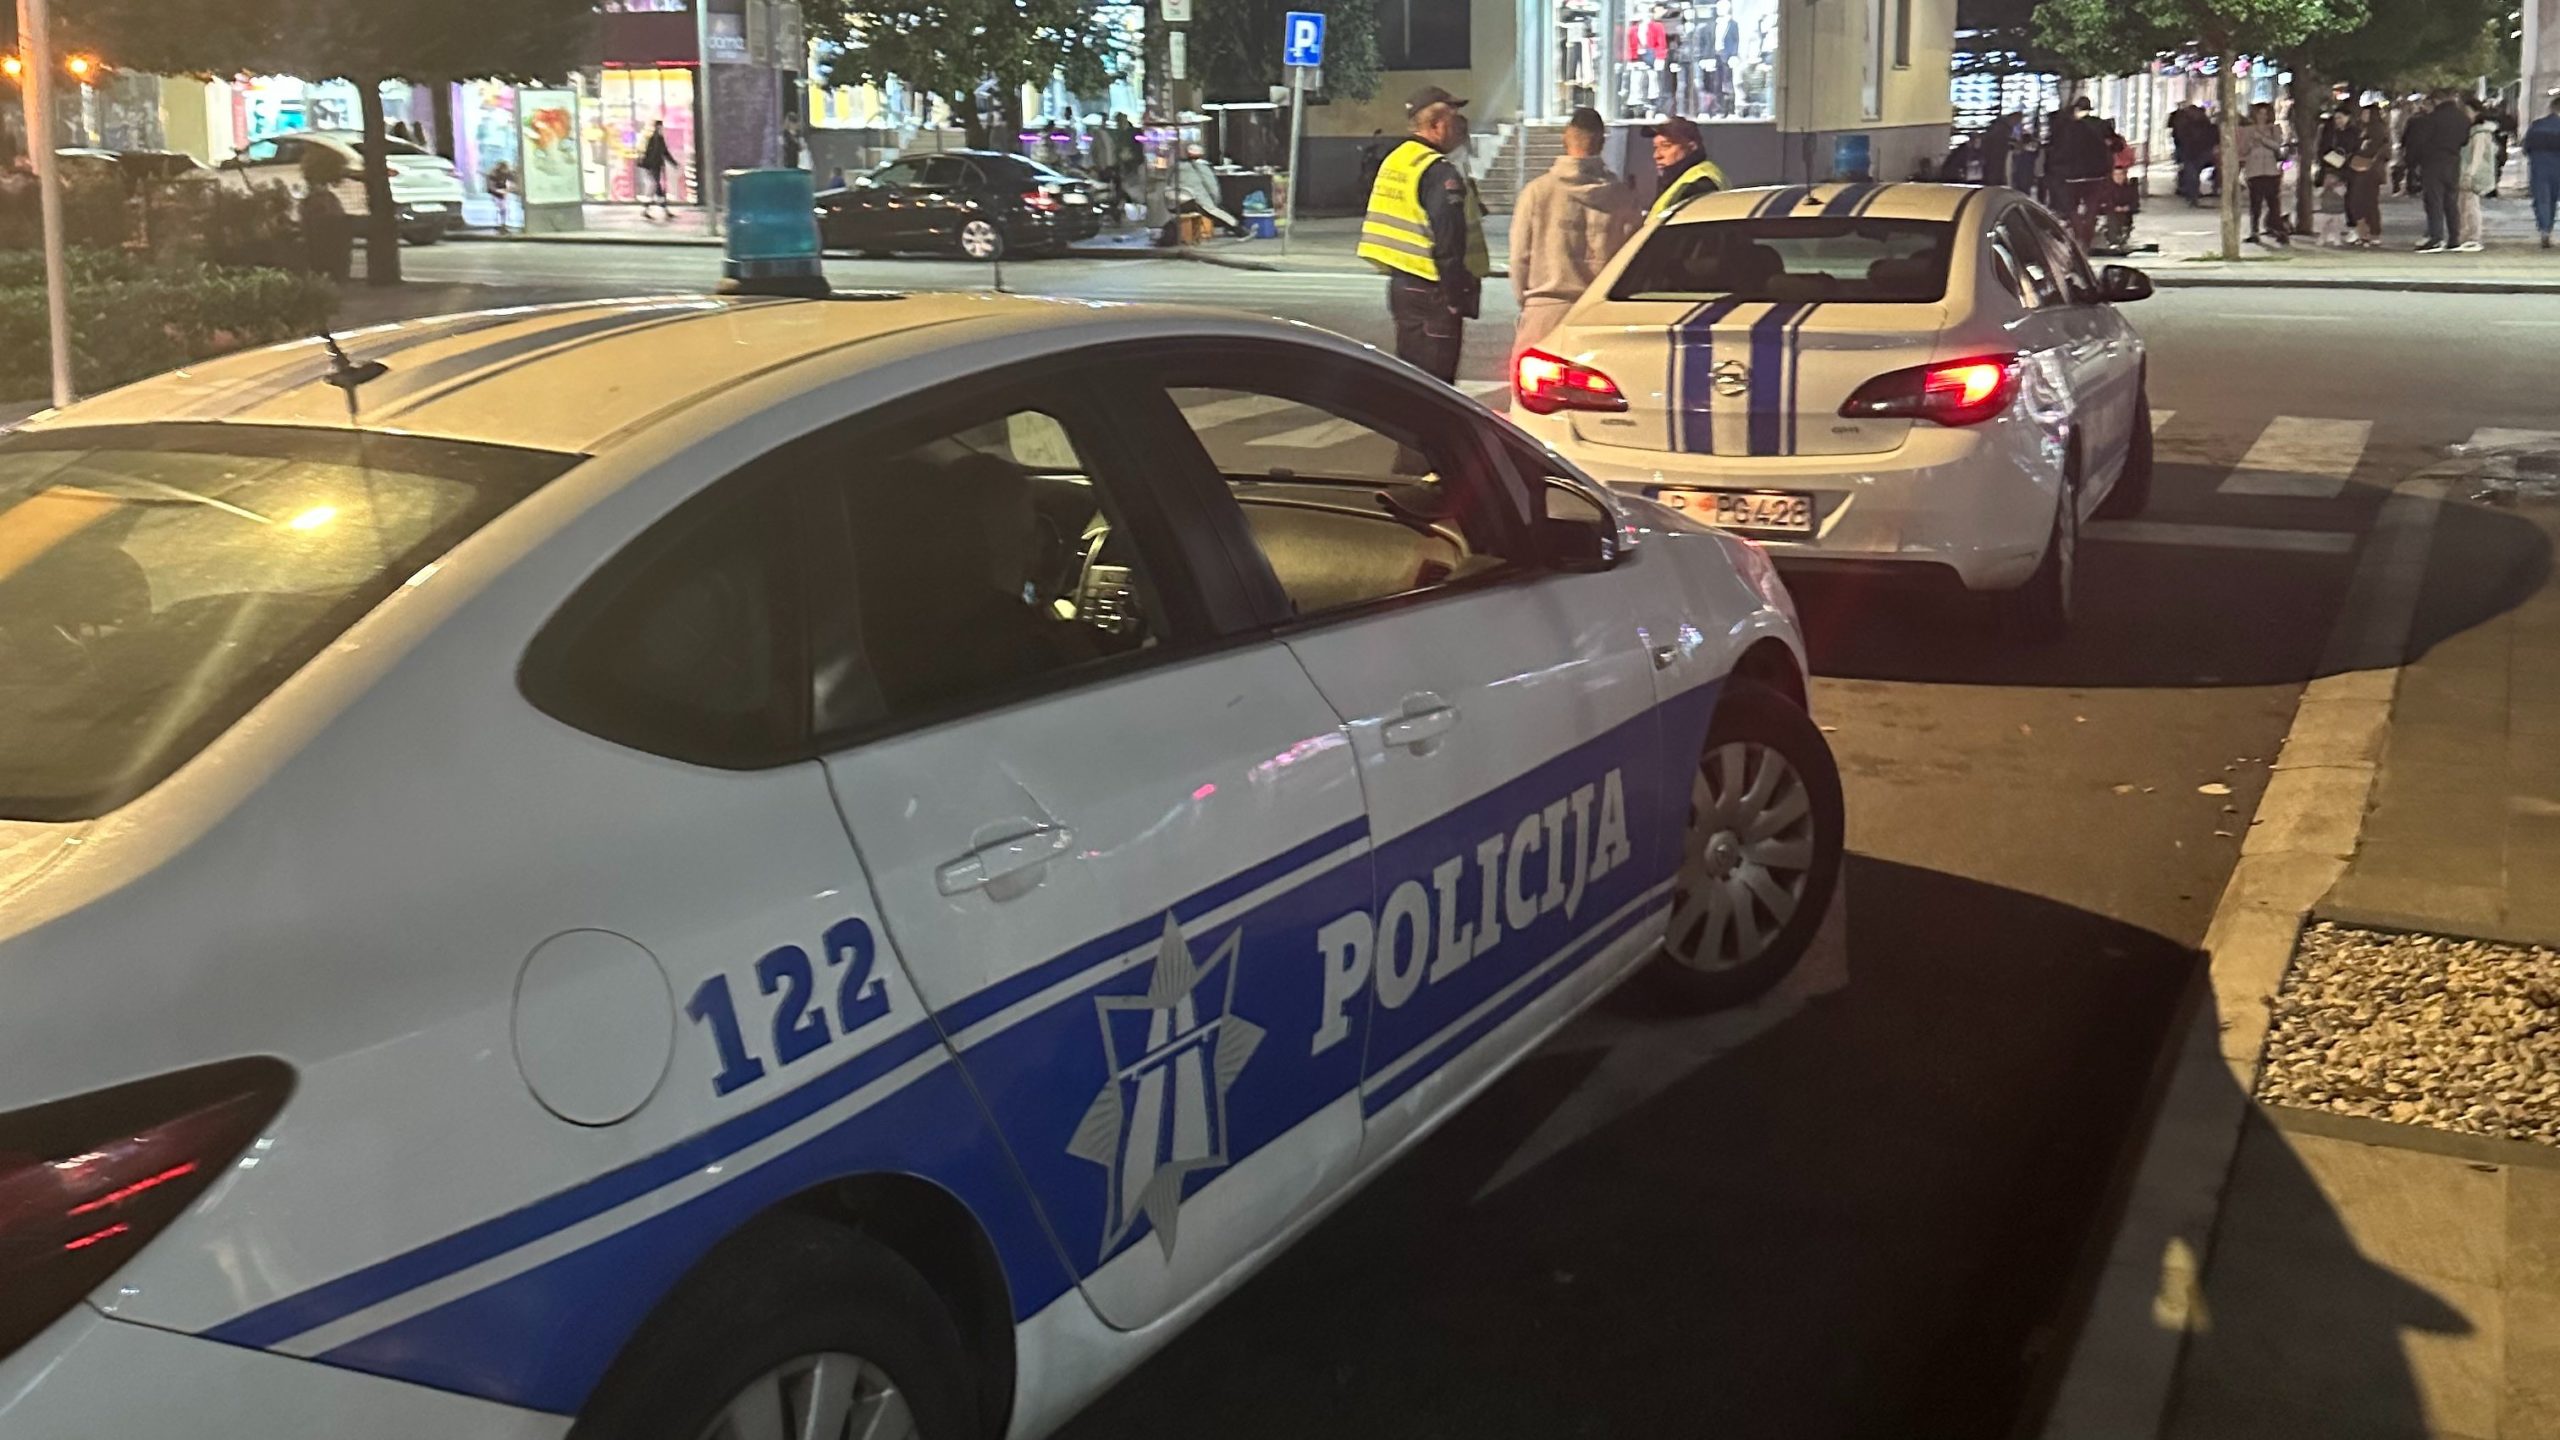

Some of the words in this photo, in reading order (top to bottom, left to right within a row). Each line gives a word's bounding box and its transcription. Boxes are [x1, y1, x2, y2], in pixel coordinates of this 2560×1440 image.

[1294, 20, 1317, 57] P
[1716, 495, 1807, 526] PG428
[1311, 767, 1631, 1057] POLICIJA
[684, 917, 891, 1098] 122
